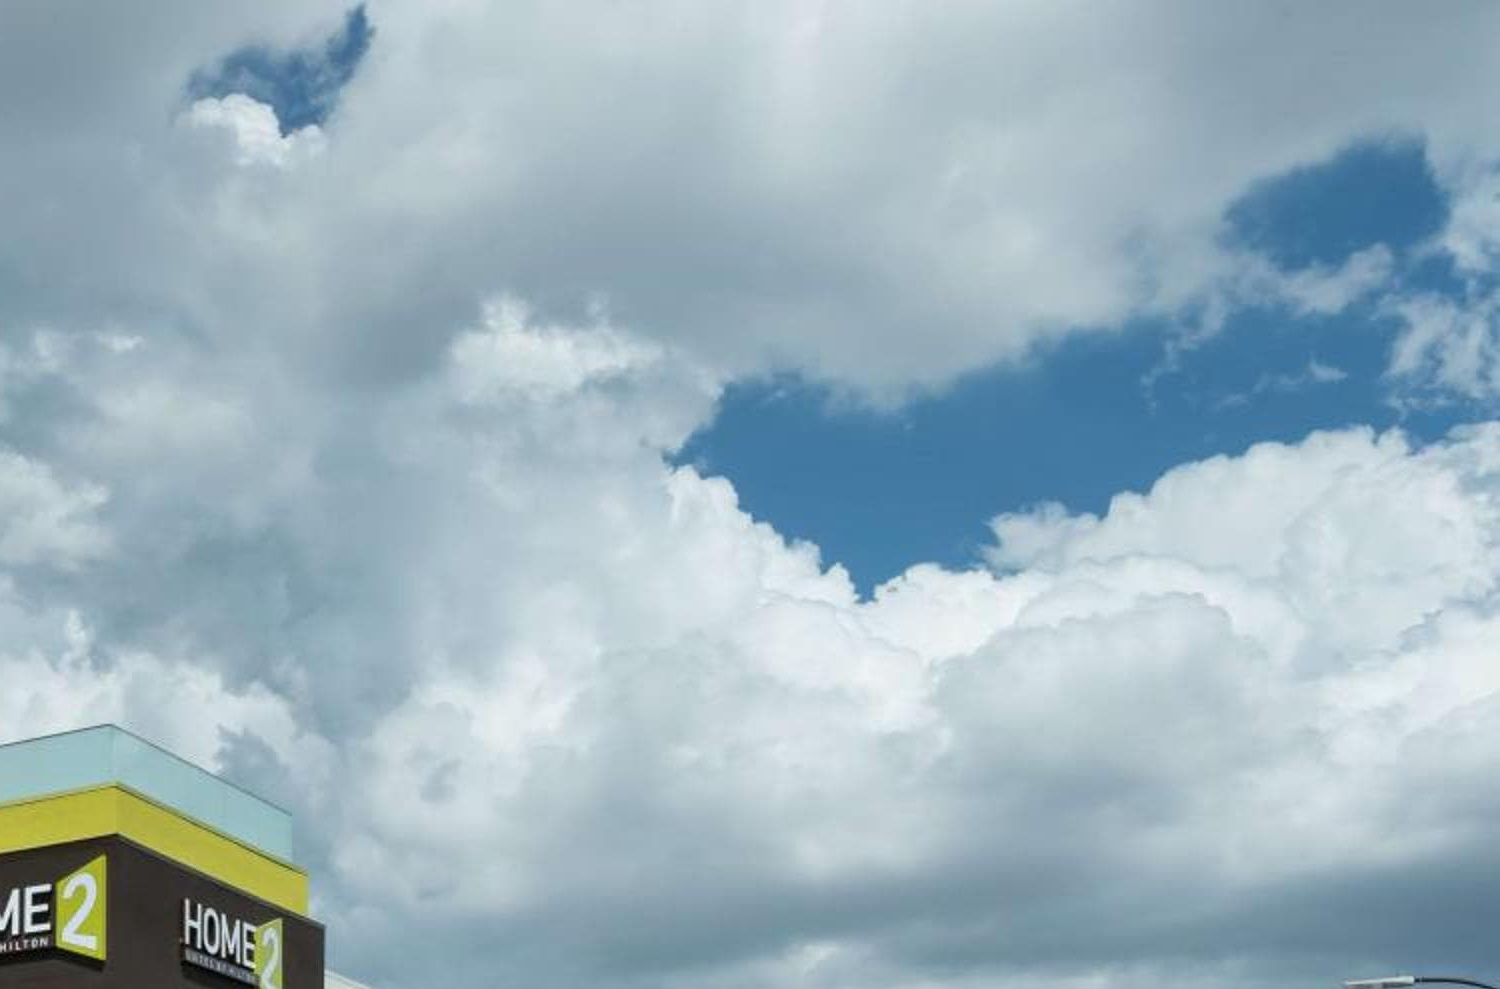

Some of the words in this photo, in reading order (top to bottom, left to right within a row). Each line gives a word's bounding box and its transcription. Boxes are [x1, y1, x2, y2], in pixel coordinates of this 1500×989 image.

[0, 935, 49, 954] HILTON
[61, 872, 97, 951] 2
[184, 898, 256, 970] HOME
